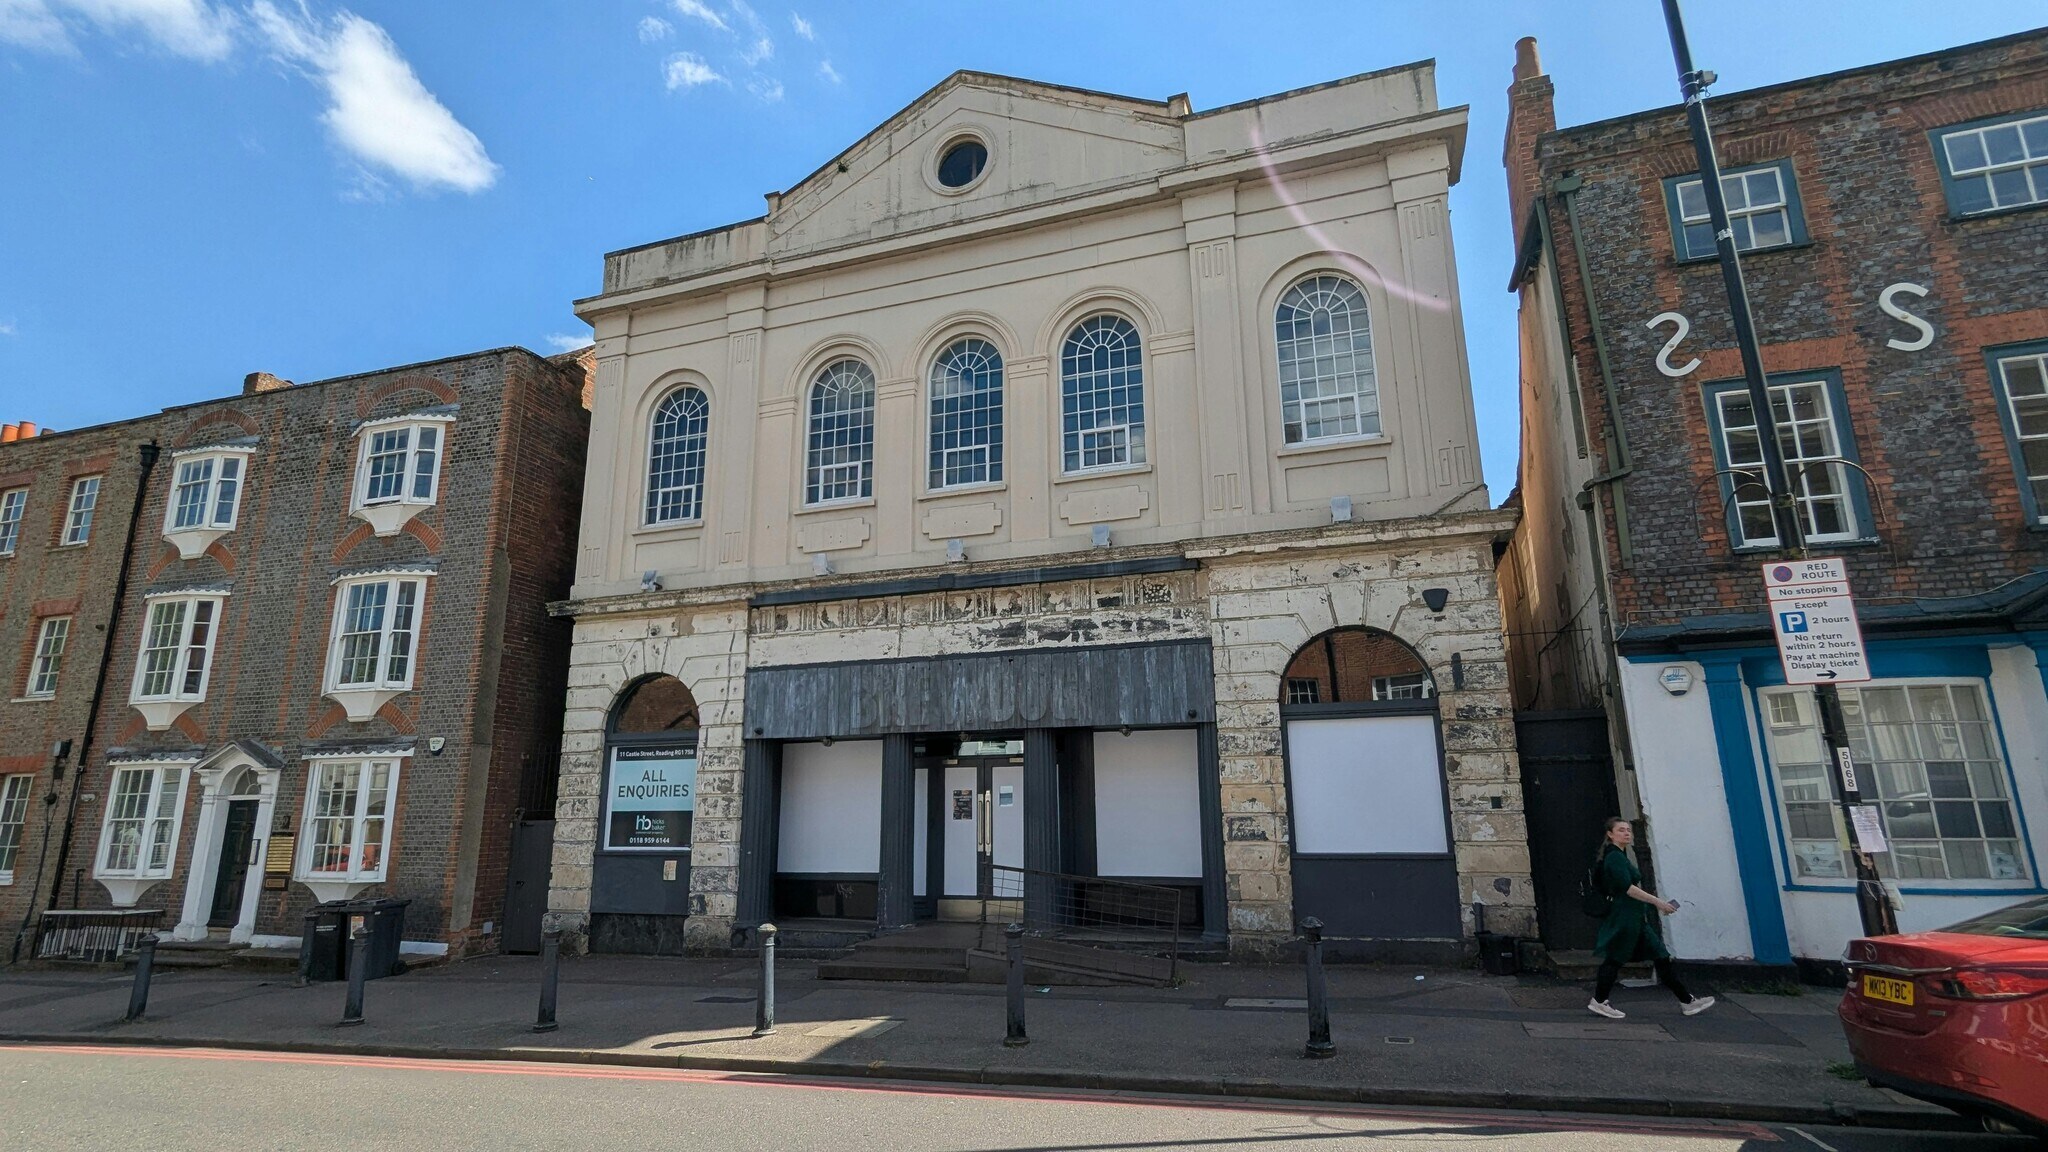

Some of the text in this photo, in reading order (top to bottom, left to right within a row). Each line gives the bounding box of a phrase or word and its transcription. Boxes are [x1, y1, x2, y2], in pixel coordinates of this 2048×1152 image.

[1807, 563, 1828, 571] RED
[1802, 571, 1837, 579] ROUTE
[1796, 586, 1837, 595] stopping
[1795, 601, 1828, 609] Except
[1786, 614, 1802, 631] P
[1822, 616, 1849, 624] hours
[1818, 641, 1826, 649] 2
[1828, 640, 1856, 648] hours
[1820, 651, 1860, 659] machine
[1791, 659, 1858, 670] Display ticket
[1841, 751, 1854, 788] 5068
[642, 770, 667, 782] ALL
[618, 784, 689, 799] ENQUIRIES
[1888, 981, 1907, 1000] YBC
